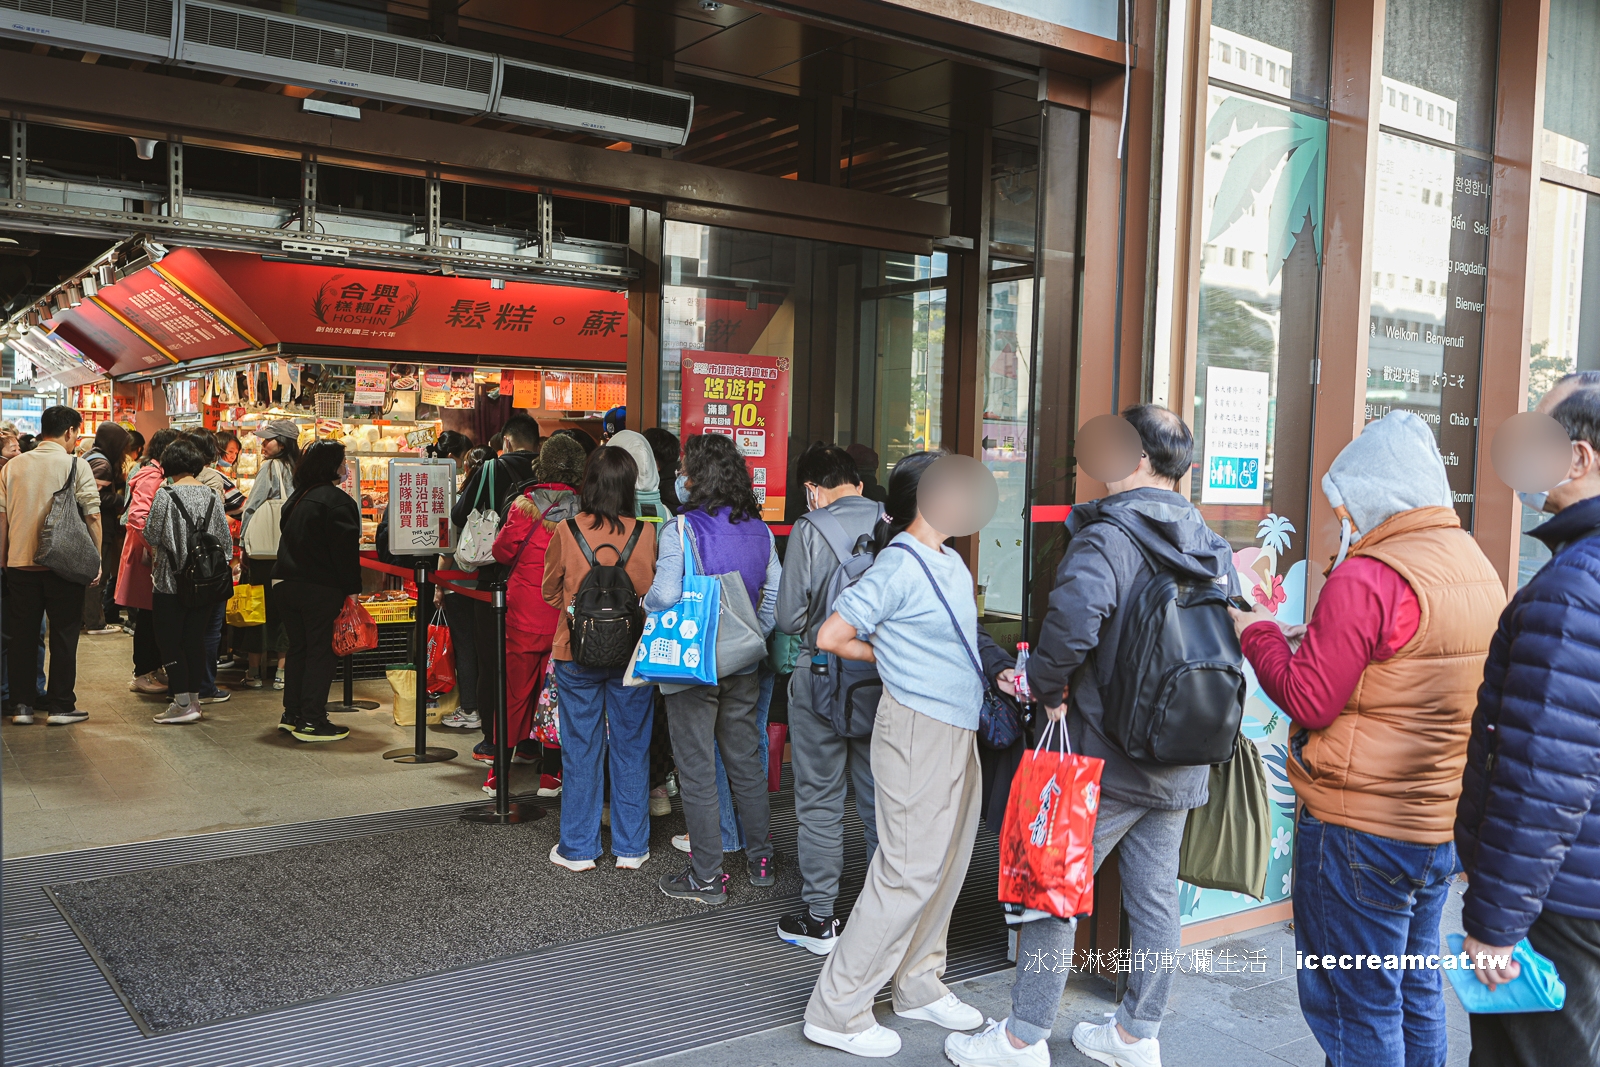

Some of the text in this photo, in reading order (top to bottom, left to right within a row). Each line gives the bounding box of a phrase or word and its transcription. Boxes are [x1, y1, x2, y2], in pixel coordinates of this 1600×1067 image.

[341, 283, 399, 302] 合興
[334, 301, 394, 316] 糕糰店
[333, 314, 387, 326] HOSHIN
[316, 326, 396, 338] 創始於民國三十六年
[1386, 325, 1419, 342] Welkom
[1426, 331, 1465, 348] Benvenuti
[1383, 366, 1420, 384] 歡迎光臨
[1431, 372, 1465, 389] ようこそ
[704, 377, 766, 402] 悠遊付
[707, 404, 728, 415] 滿額
[732, 403, 766, 427] 10%
[1449, 412, 1470, 426] Chào
[399, 472, 413, 529] 排隊購買
[415, 472, 429, 528] 請沿紅龍
[431, 486, 445, 515] 鬆糕
